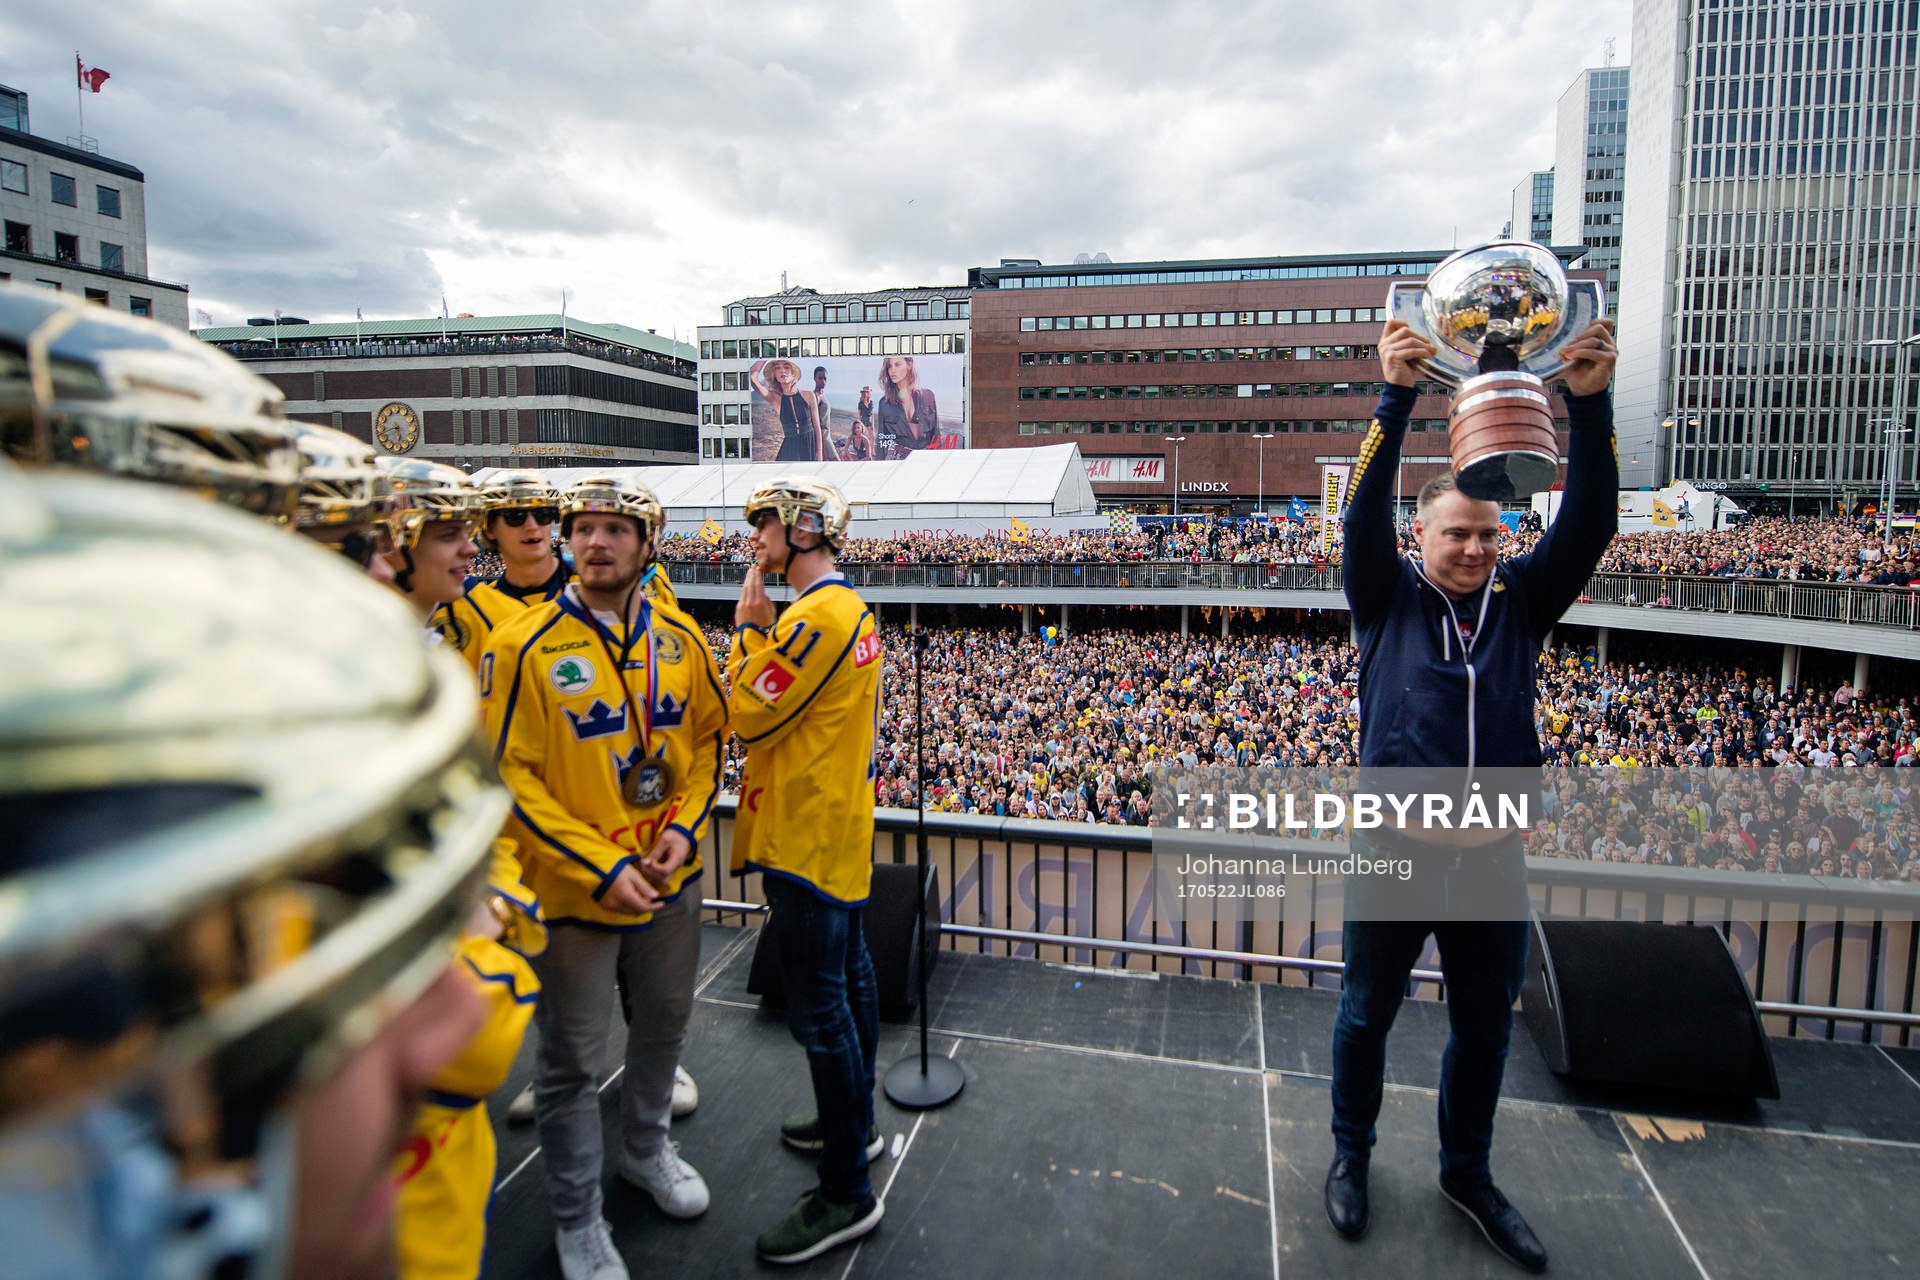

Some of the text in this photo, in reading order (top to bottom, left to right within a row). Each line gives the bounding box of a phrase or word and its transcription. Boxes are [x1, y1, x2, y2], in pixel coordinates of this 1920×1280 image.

[1087, 460, 1111, 478] H&M
[1133, 460, 1159, 478] H&M
[1181, 481, 1229, 492] LINDEX
[1691, 482, 1728, 490] ANGO
[775, 621, 822, 669] 11
